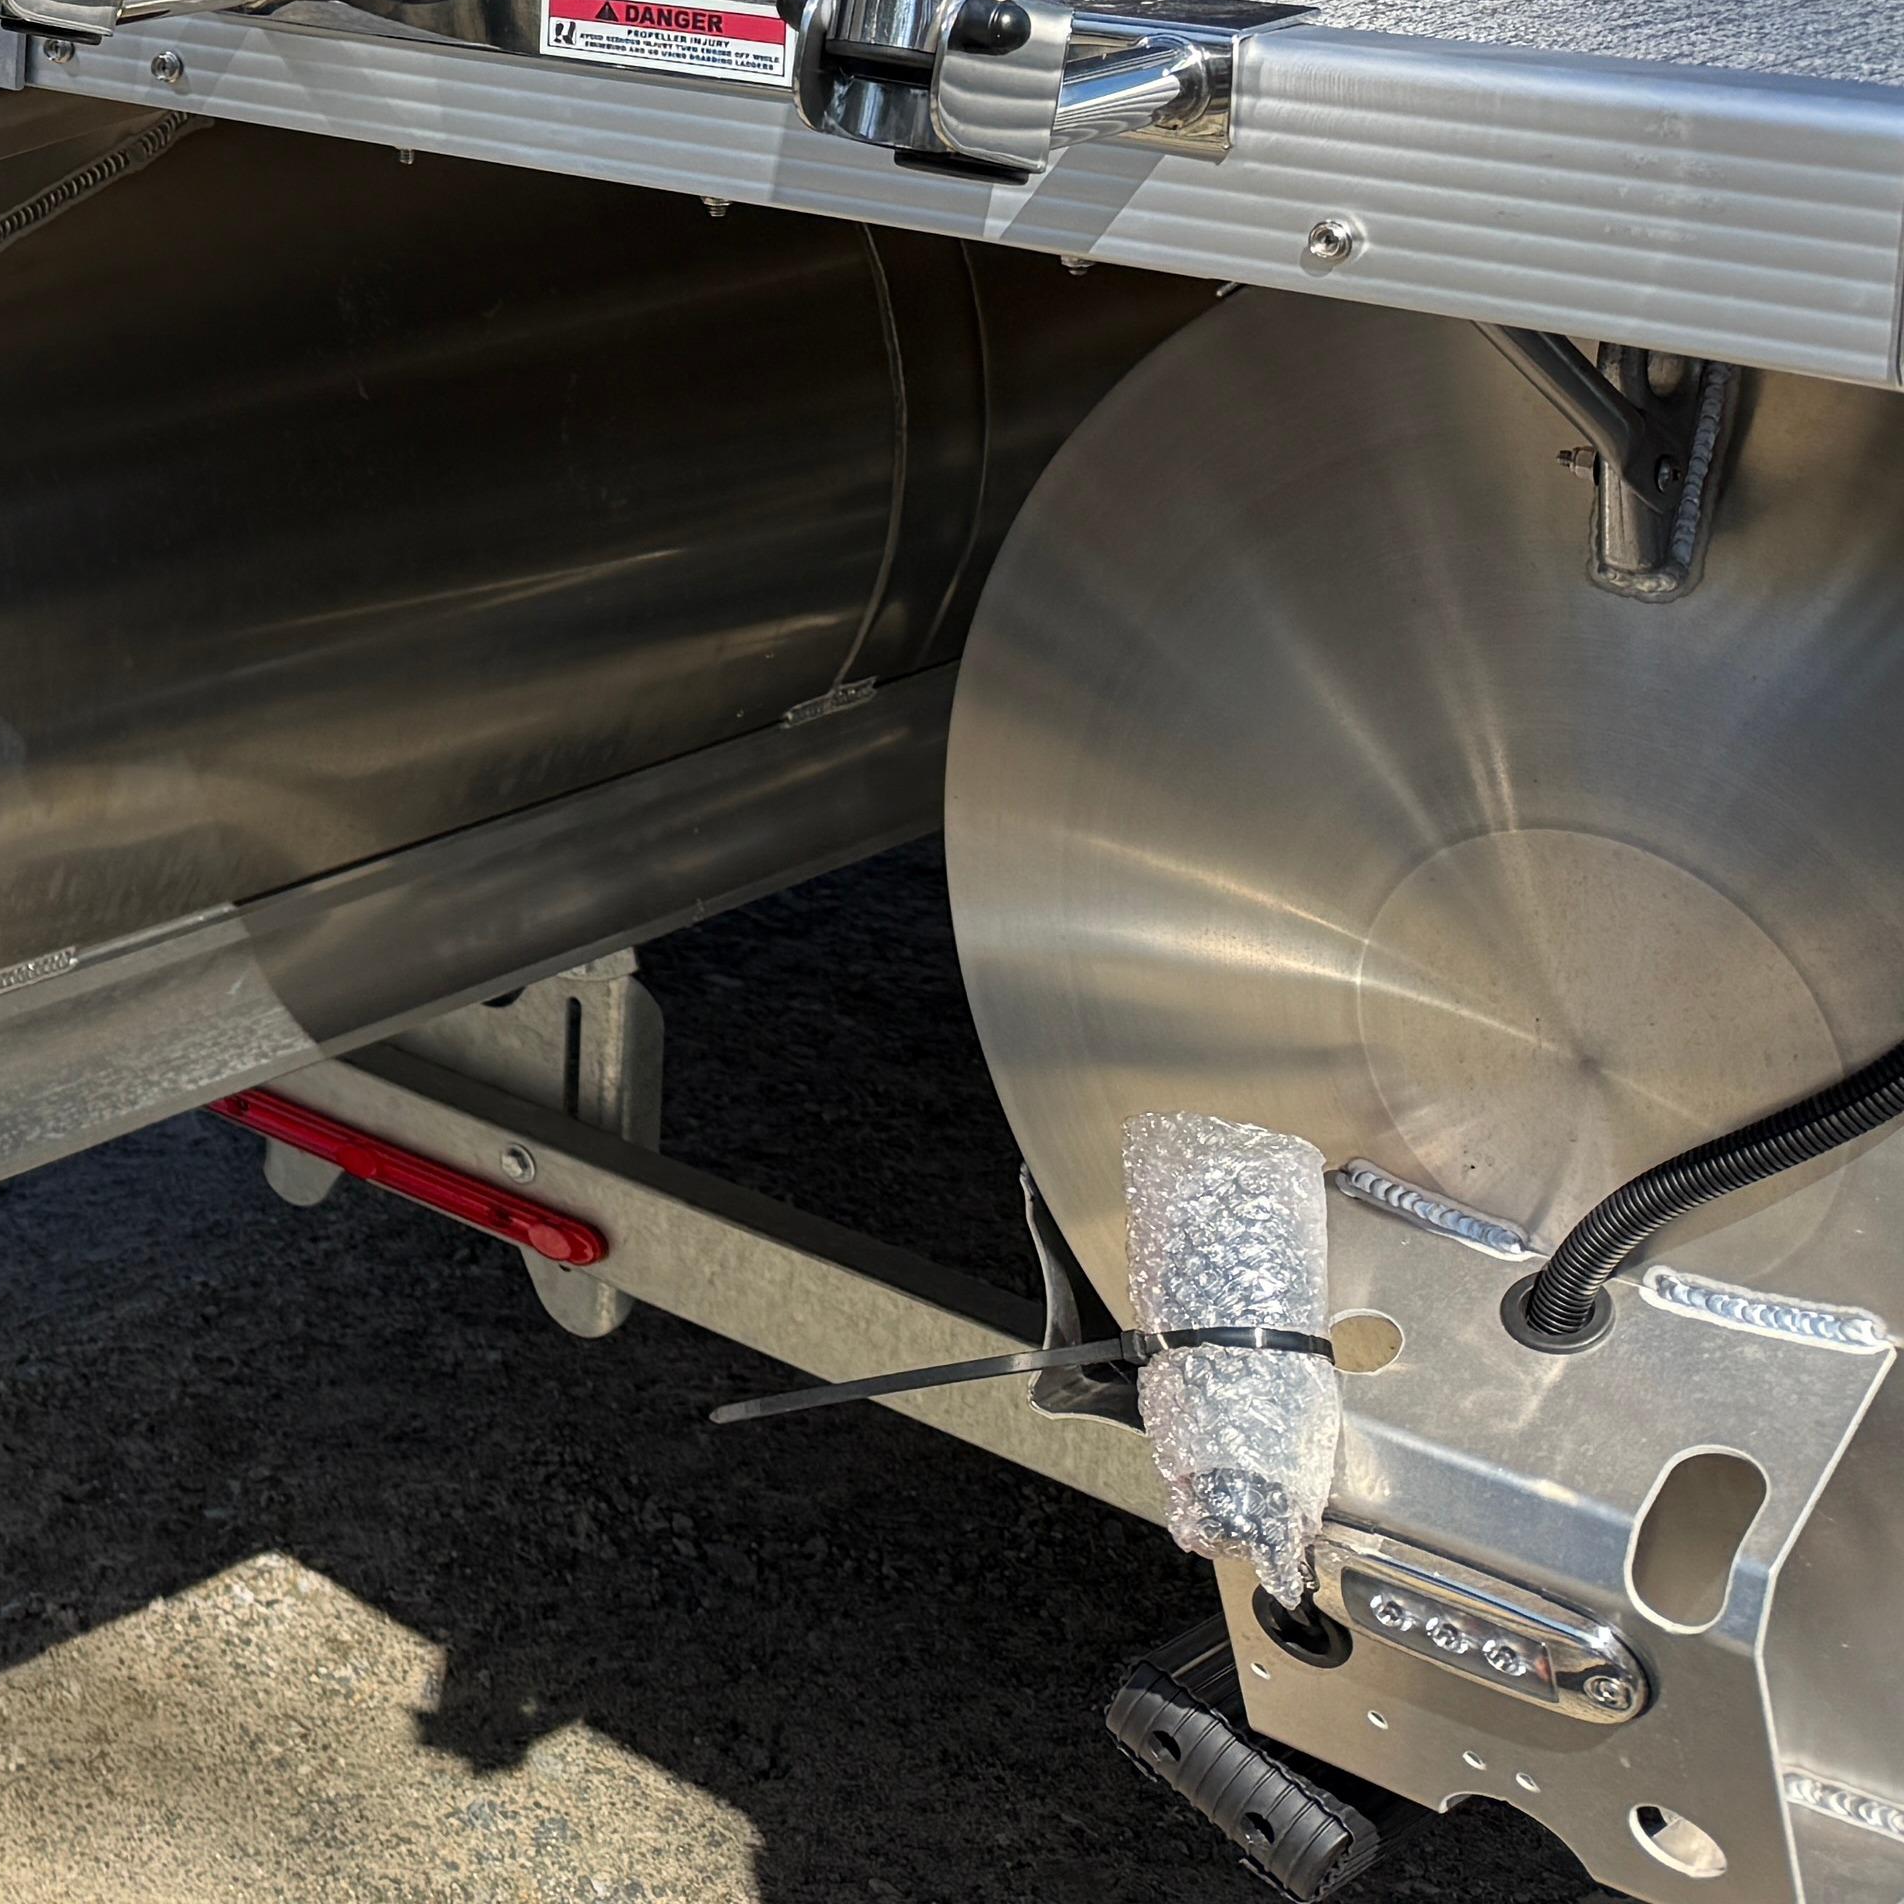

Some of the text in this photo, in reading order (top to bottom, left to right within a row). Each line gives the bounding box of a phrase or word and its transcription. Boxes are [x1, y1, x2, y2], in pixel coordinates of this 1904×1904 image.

[624, 3, 723, 34] DANGER
[626, 28, 730, 48] PROPELLER INJURY
